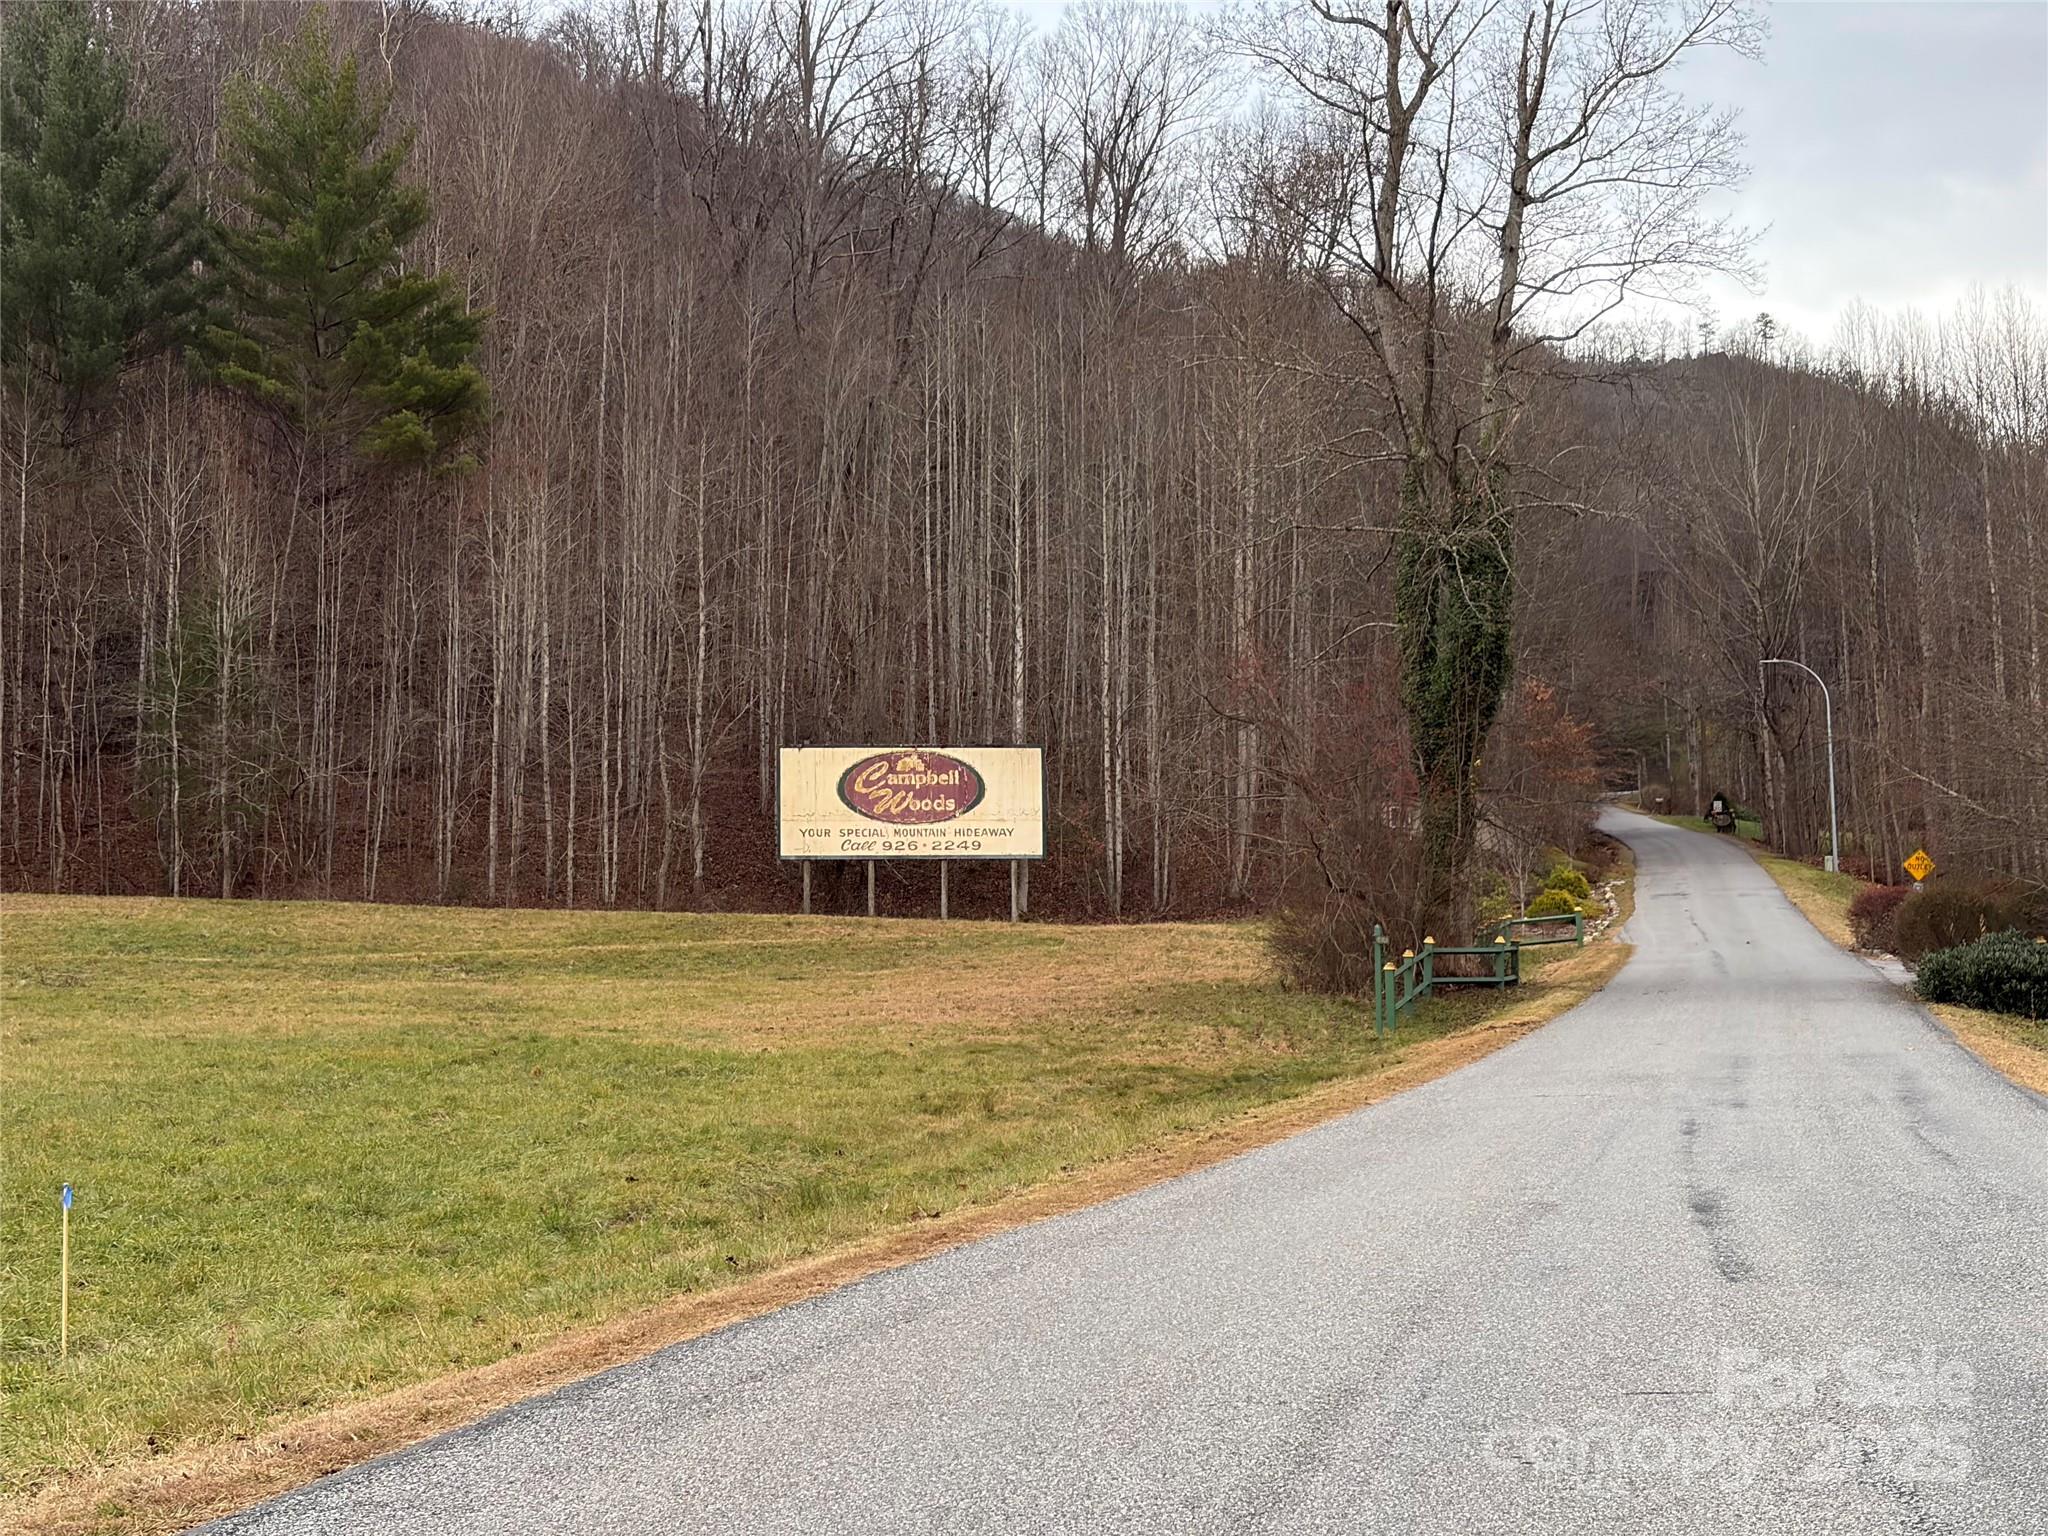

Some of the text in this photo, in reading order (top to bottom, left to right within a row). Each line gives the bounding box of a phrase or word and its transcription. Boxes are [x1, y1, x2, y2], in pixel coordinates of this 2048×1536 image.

[855, 761, 960, 794] Campbell
[869, 788, 956, 815] Woods
[800, 828, 1015, 838] YOUR SPECIAL MOUNTAIN HIDEAWAY
[841, 840, 876, 852] Call
